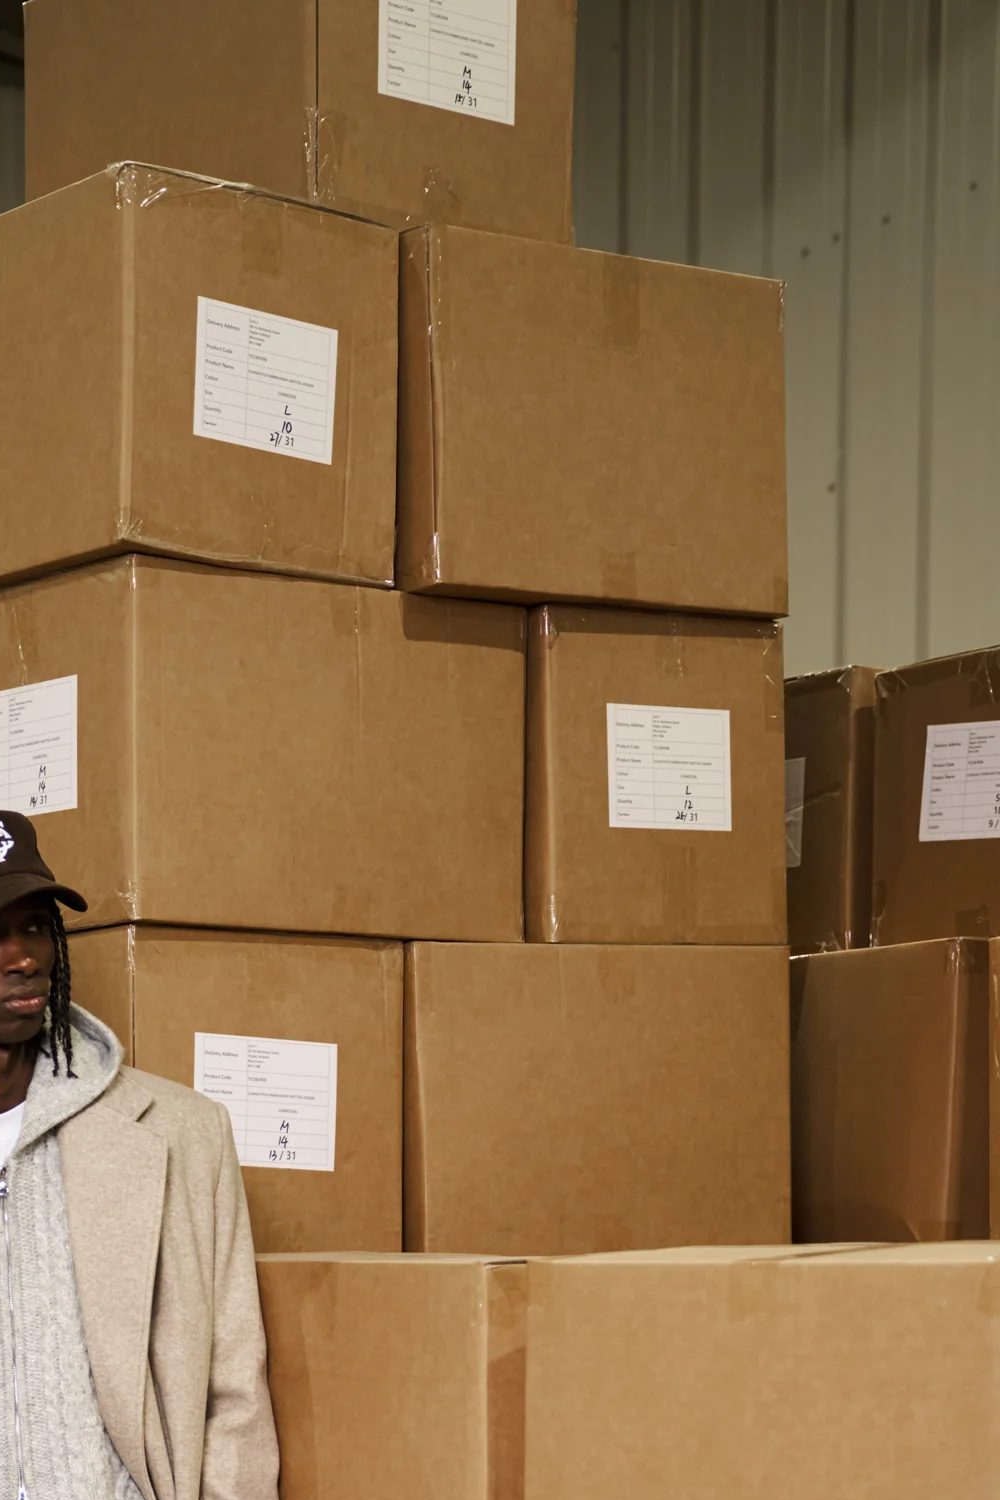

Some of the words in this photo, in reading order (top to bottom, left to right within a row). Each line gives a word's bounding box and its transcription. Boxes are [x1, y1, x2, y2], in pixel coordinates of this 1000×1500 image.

[463, 66, 472, 78] M
[207, 319, 223, 328] Delivery
[224, 323, 240, 332] Address
[206, 344, 222, 352] Product
[206, 359, 222, 368] Product
[284, 406, 291, 416] L
[282, 421, 292, 433] 10
[39, 765, 46, 778] M
[686, 786, 691, 795] L
[684, 800, 693, 809] 12
[280, 1120, 289, 1133] M
[278, 1136, 288, 1148] 14
